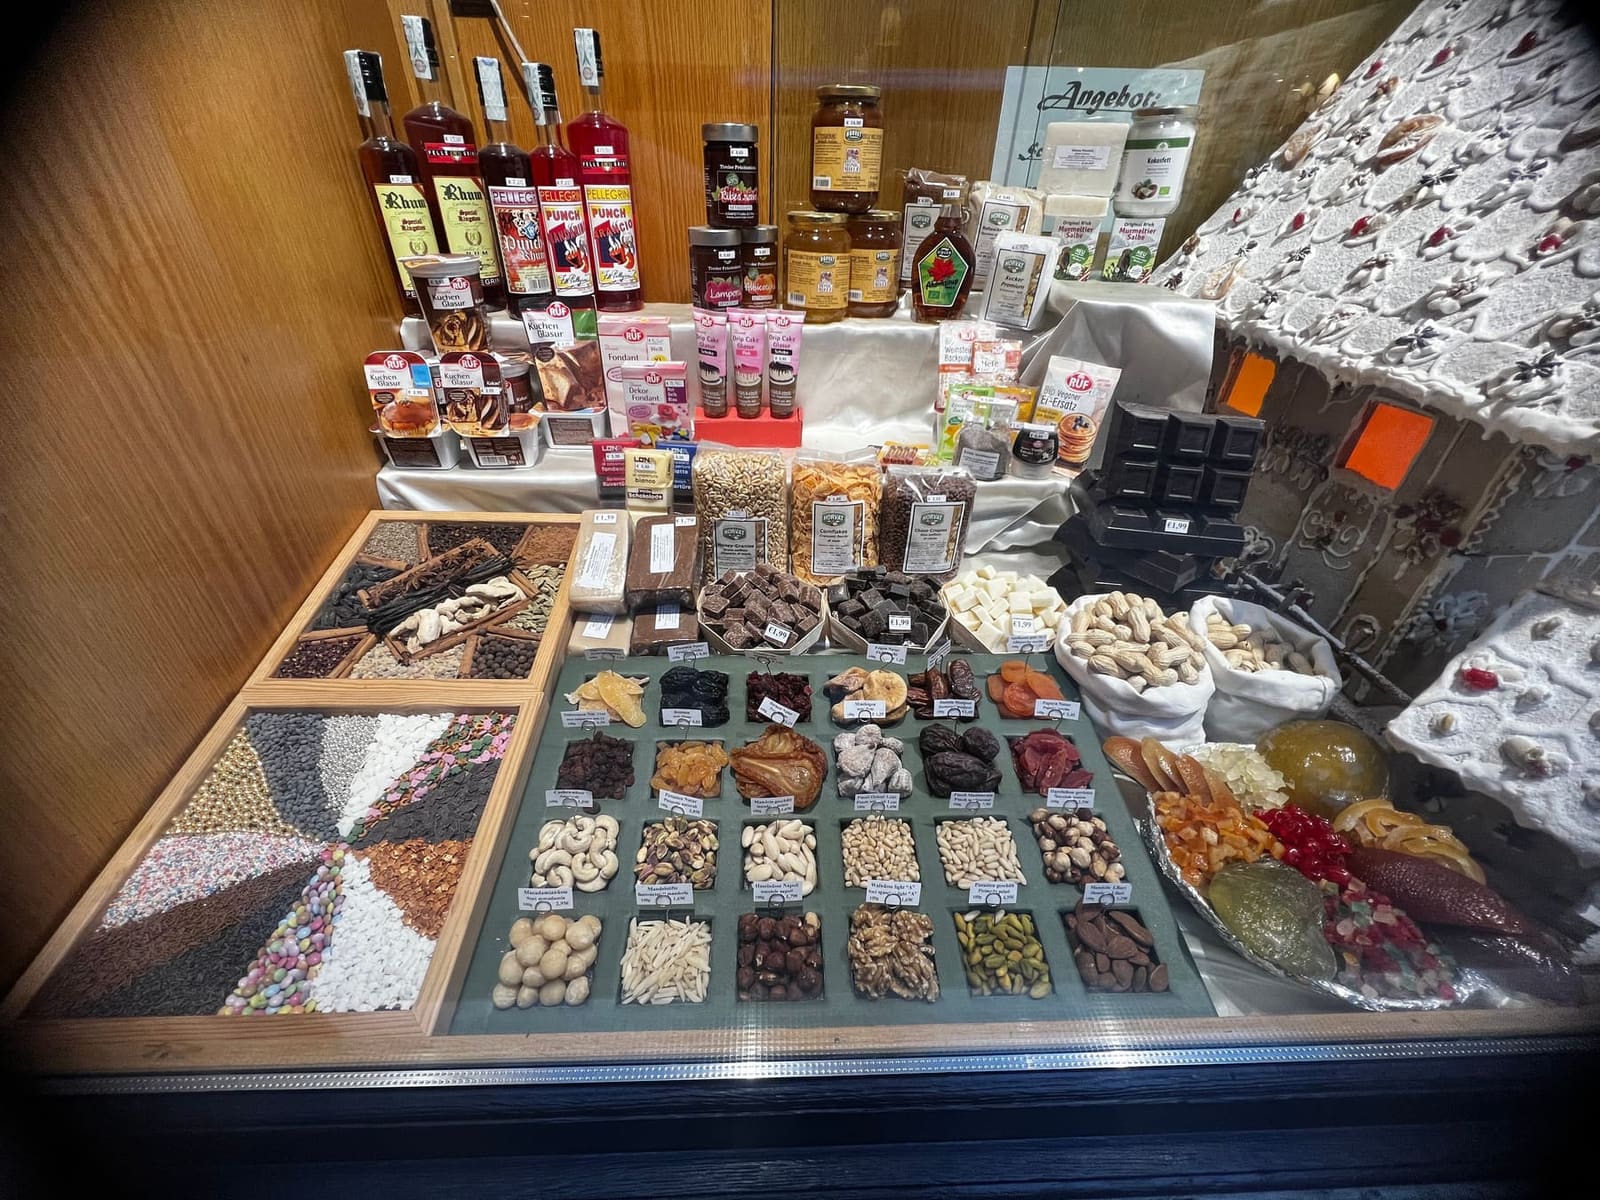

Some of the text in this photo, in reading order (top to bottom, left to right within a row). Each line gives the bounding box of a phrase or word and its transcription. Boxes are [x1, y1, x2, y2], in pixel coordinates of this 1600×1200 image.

[441, 184, 483, 201] Rhum
[382, 192, 427, 209] Rhum
[546, 210, 580, 220] PUNCH
[592, 208, 626, 218] PUNCH
[1058, 225, 1094, 233] Murmeltier
[550, 308, 566, 316] RUF
[528, 322, 559, 330] Kuchen
[538, 330, 564, 338] Glasur
[626, 332, 641, 340] RUF
[769, 334, 781, 342] Drip
[608, 352, 639, 361] Fondant
[387, 360, 404, 368] RUF
[462, 360, 478, 368] RUF
[982, 360, 1000, 368] Hefe
[1070, 378, 1090, 389] RUF
[1040, 394, 1078, 412] Ei-Ersatz
[1166, 522, 1188, 531] €1,99
[1013, 620, 1032, 628] €1,99
[768, 626, 787, 640] €1,99
